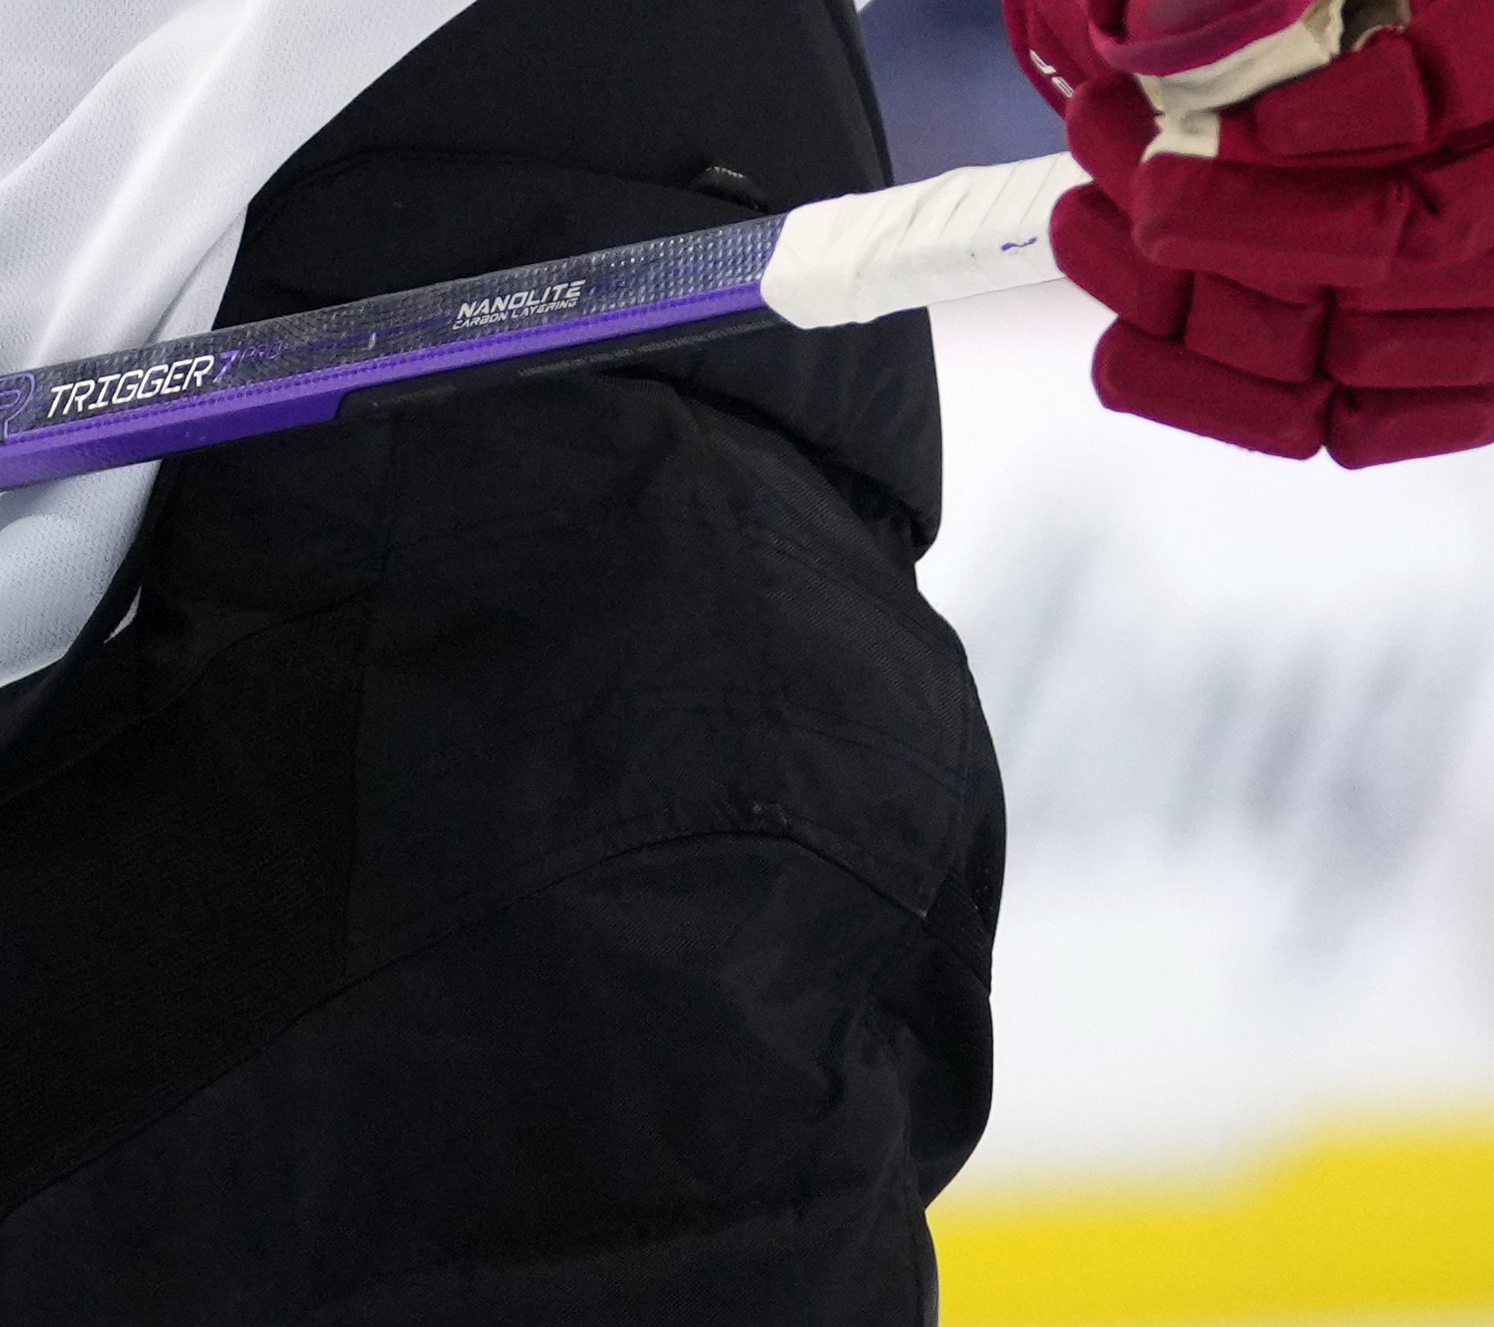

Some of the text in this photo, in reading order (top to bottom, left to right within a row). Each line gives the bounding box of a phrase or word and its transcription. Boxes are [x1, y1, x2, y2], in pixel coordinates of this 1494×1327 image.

[452, 296, 579, 331] CARBON LAYERING
[457, 279, 587, 320] NANOLITE
[47, 354, 215, 418] TRIGGER
